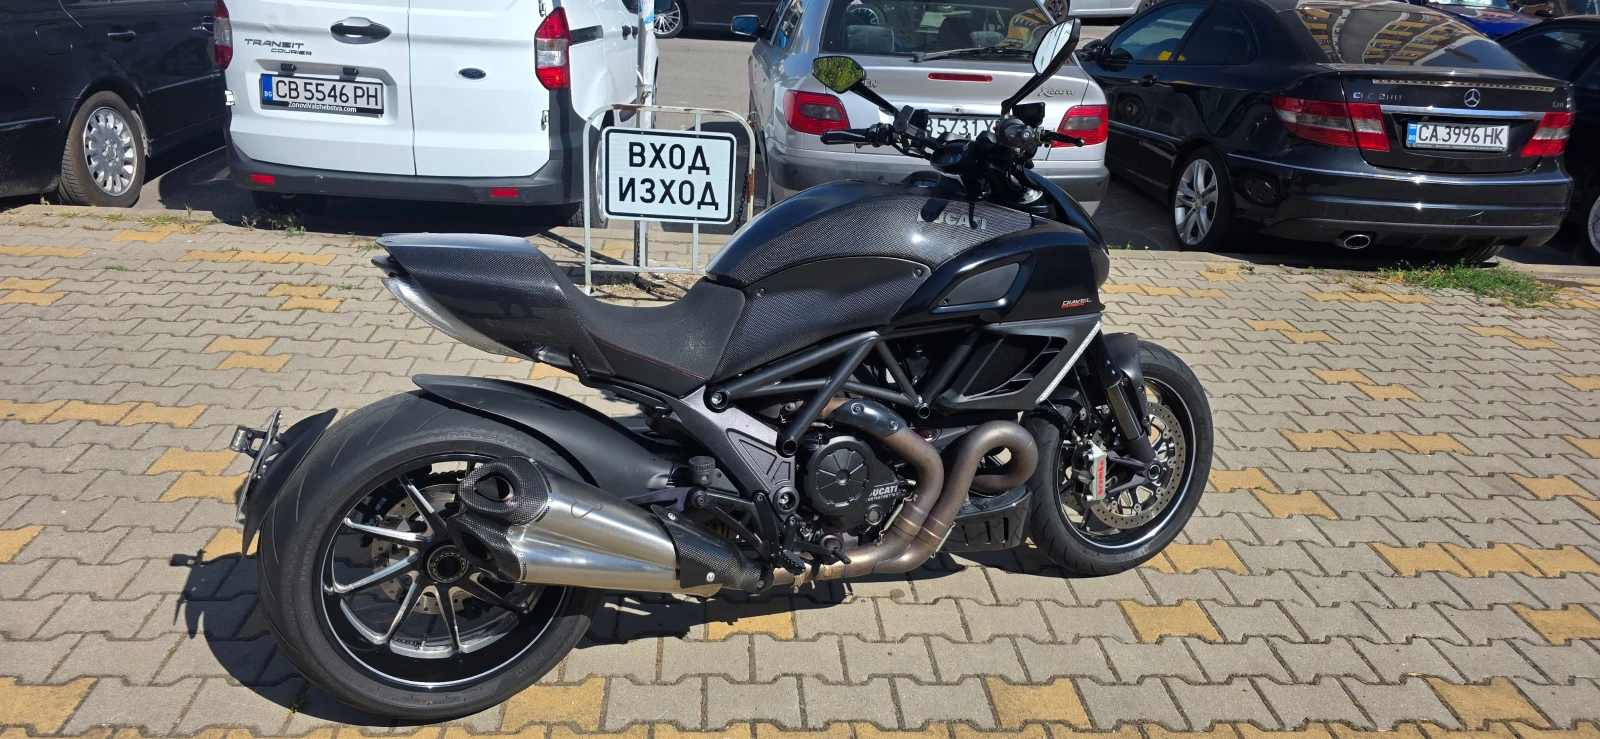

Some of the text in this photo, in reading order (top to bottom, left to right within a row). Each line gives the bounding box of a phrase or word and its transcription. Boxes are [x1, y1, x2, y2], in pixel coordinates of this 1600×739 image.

[244, 38, 304, 50] TRANSIT
[270, 48, 312, 56] COURIER
[275, 79, 378, 106] CB 5546 PH
[937, 117, 978, 136] 5731
[1418, 124, 1504, 145] CA 3996 HK
[628, 142, 710, 175] ВХОД
[618, 177, 719, 211] ИЗХОД
